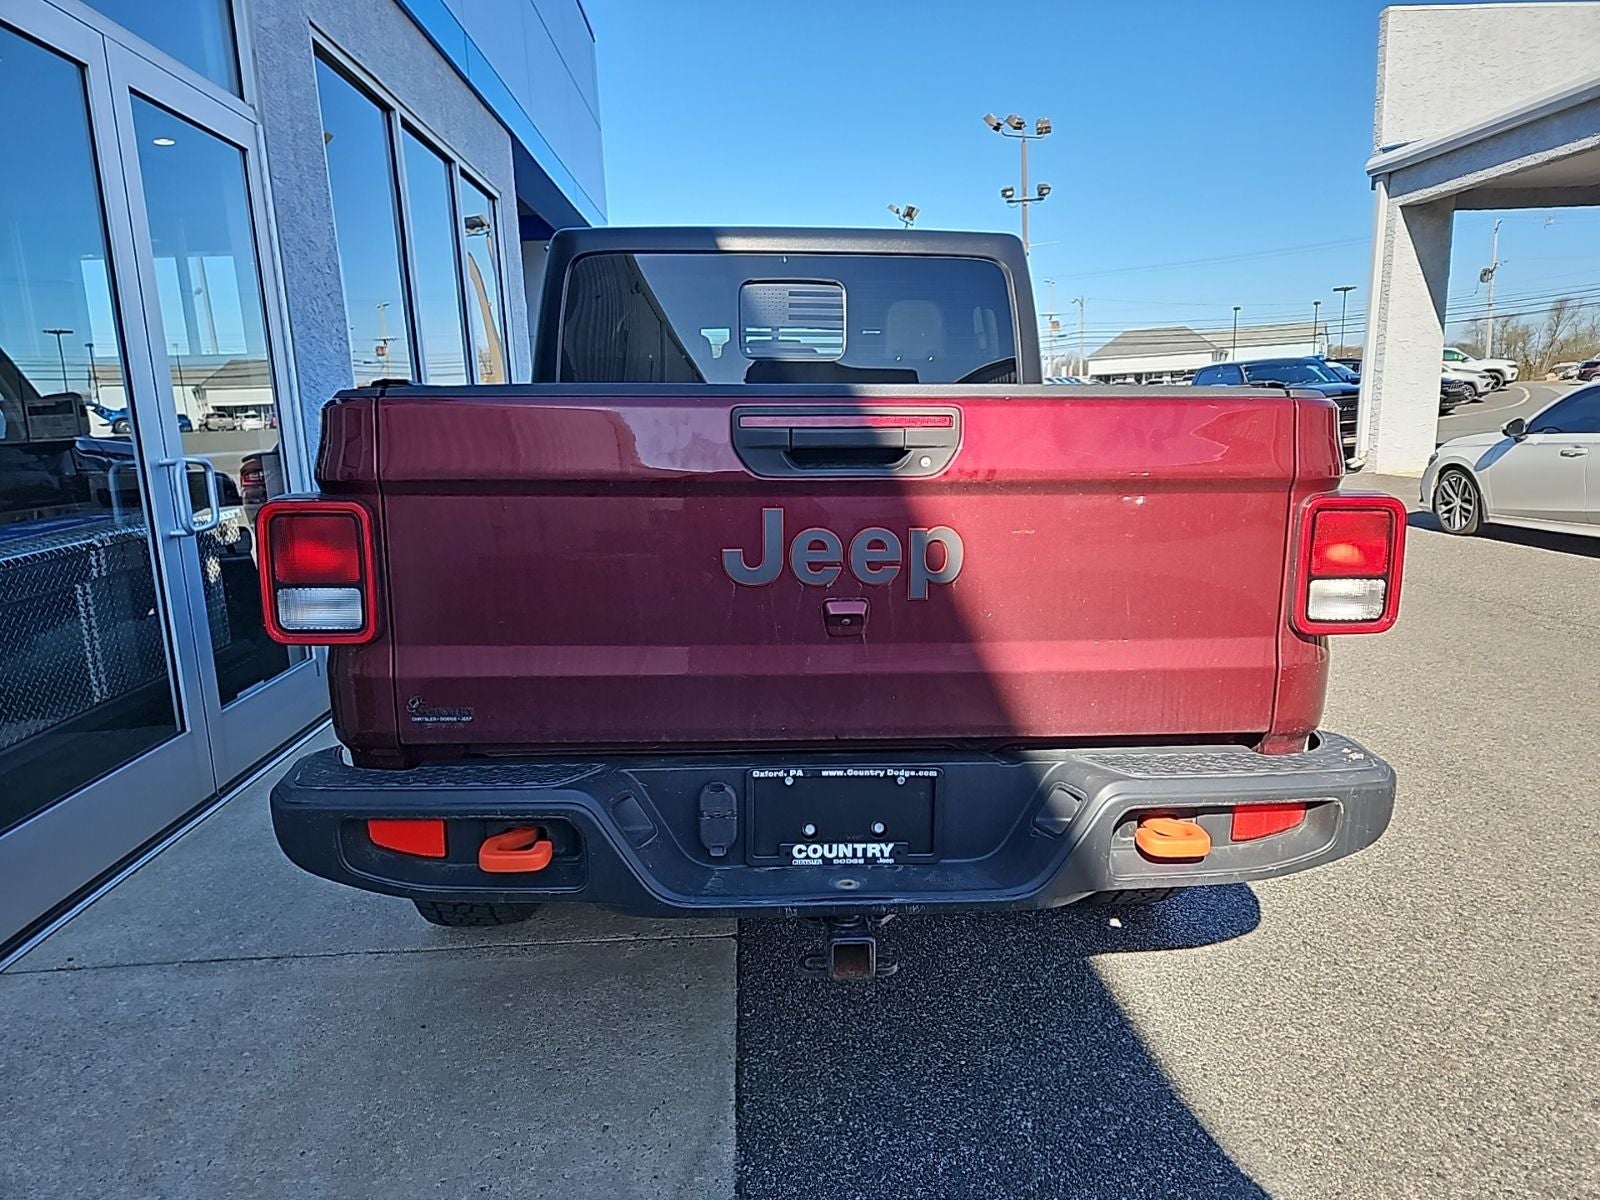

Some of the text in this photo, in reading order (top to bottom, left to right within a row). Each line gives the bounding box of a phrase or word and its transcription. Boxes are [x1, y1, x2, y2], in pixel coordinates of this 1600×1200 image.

[722, 508, 964, 600] Jeep
[789, 769, 804, 777] PA
[792, 843, 894, 858] COUNTRY
